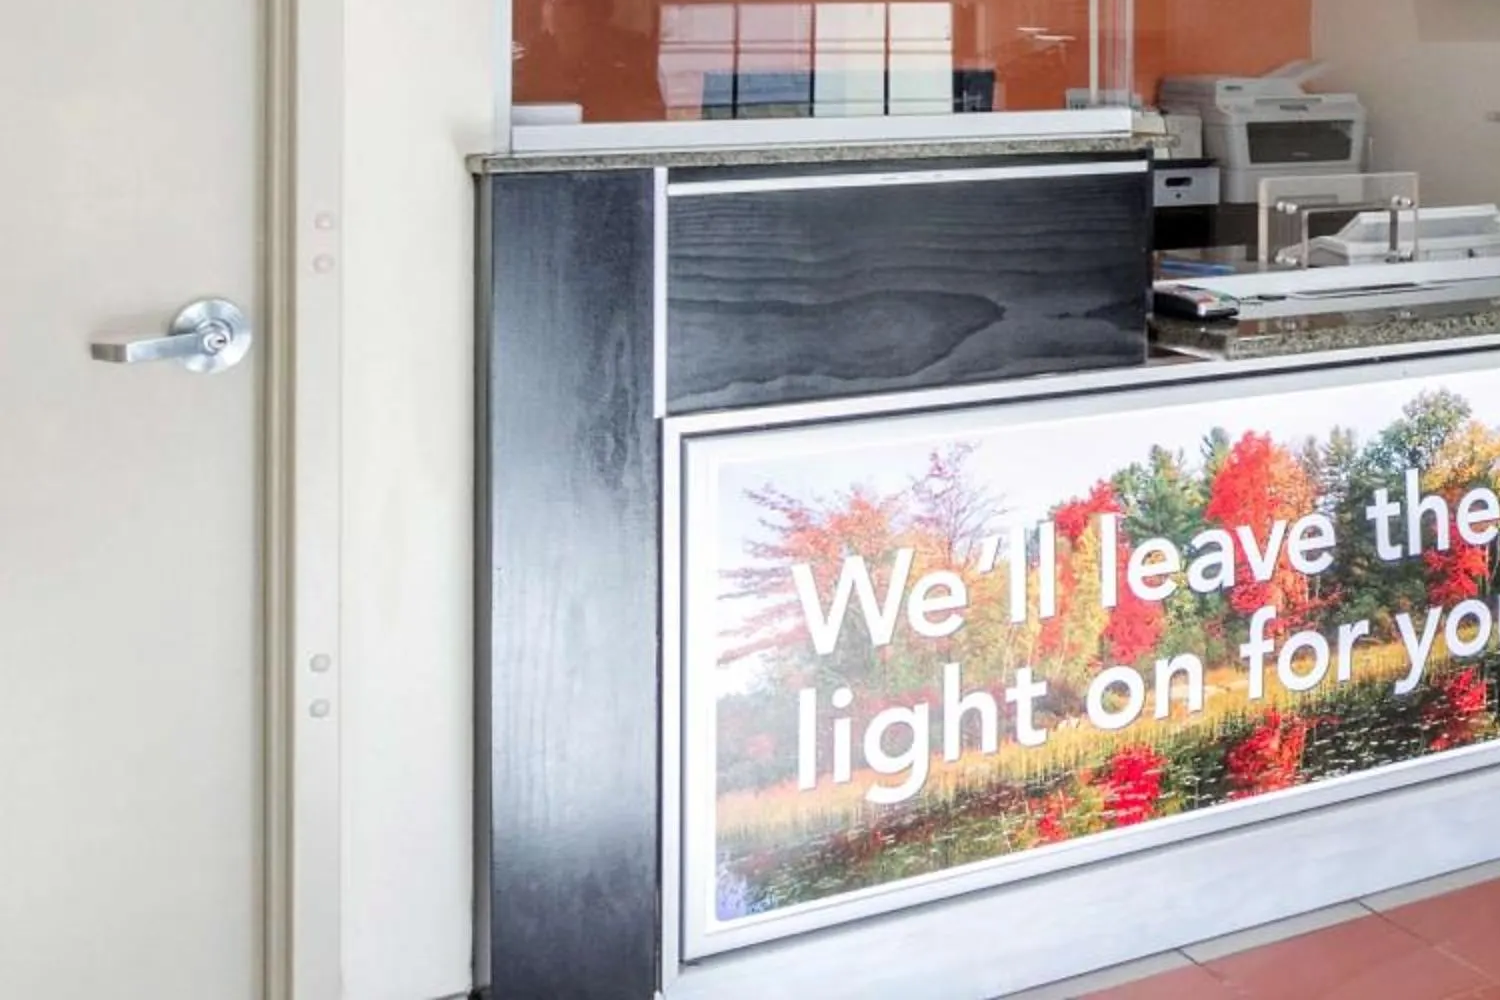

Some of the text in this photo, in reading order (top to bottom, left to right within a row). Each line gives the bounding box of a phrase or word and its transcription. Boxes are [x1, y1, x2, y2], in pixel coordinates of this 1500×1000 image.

[791, 468, 1500, 656] We'll leave the
[797, 662, 1048, 805] light
[1086, 652, 1205, 730] on
[1240, 605, 1370, 700] for
